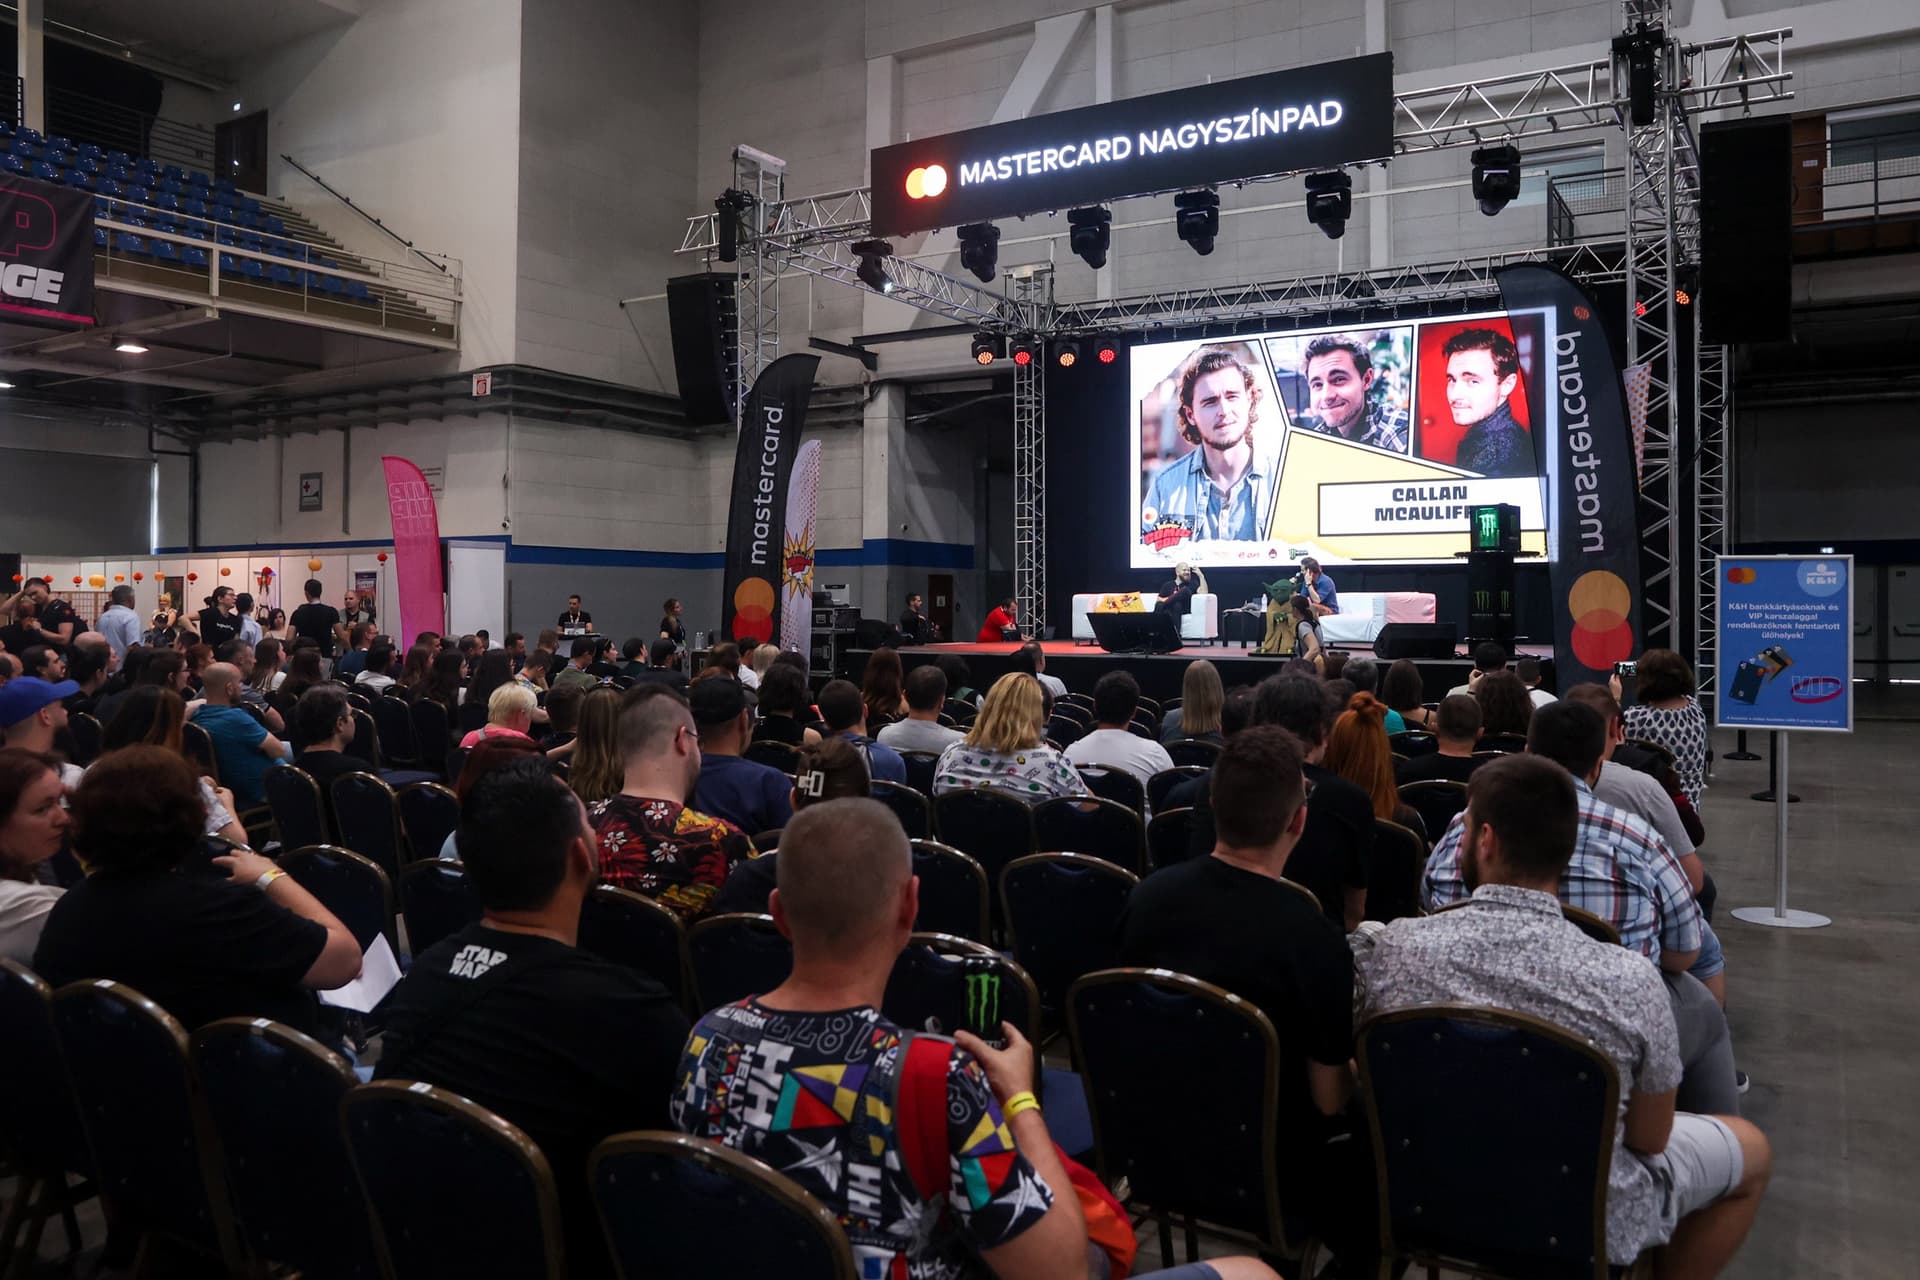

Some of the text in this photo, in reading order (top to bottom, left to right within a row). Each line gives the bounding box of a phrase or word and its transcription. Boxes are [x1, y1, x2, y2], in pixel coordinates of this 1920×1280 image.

[959, 100, 1343, 187] MASTERCARD NAGYSZÍNPAD
[751, 406, 785, 565] mastercard
[1392, 486, 1467, 502] CALLAN
[1375, 505, 1471, 521] MCAULIFF
[1806, 577, 1837, 585] K&H
[1748, 612, 1763, 620] VIP
